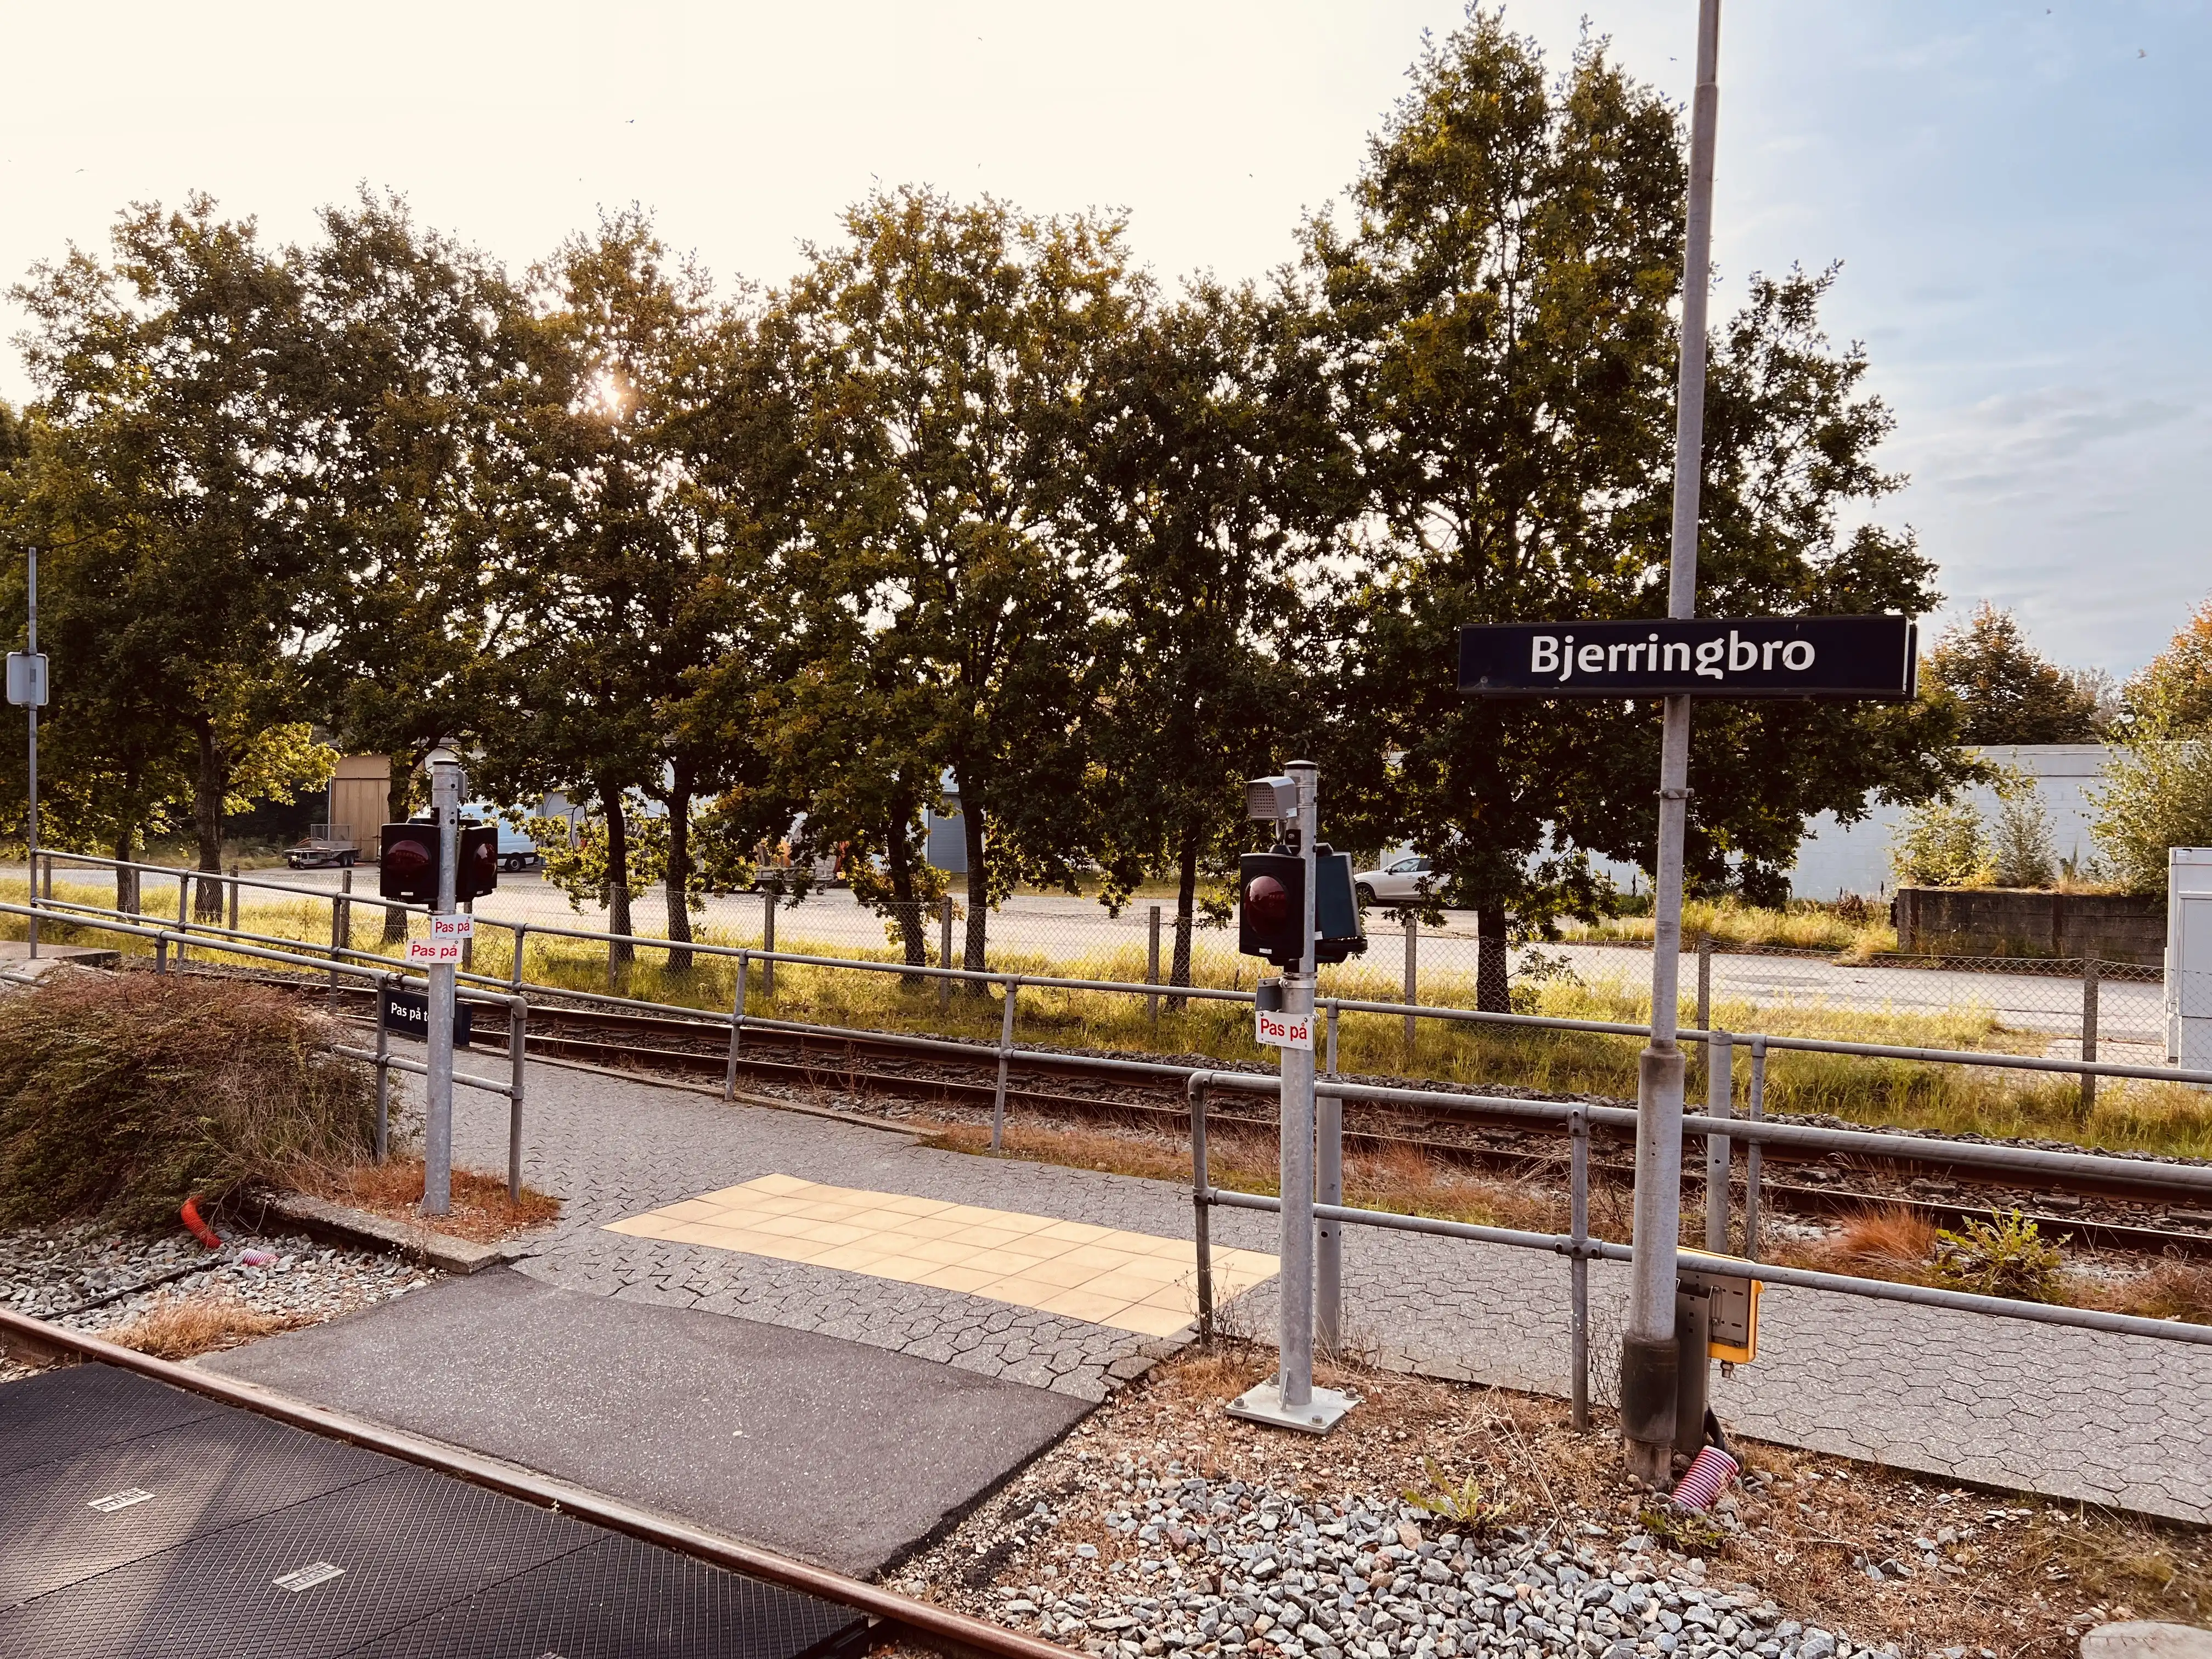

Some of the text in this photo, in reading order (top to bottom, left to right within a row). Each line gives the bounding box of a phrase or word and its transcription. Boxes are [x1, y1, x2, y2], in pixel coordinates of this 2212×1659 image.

[1531, 630, 1815, 681] Bjerringbro
[436, 919, 470, 934] Pas på
[411, 944, 458, 959] Pas på
[391, 1002, 407, 1017] Pas
[409, 1007, 421, 1021] på
[1261, 1018, 1307, 1041] Pas på
